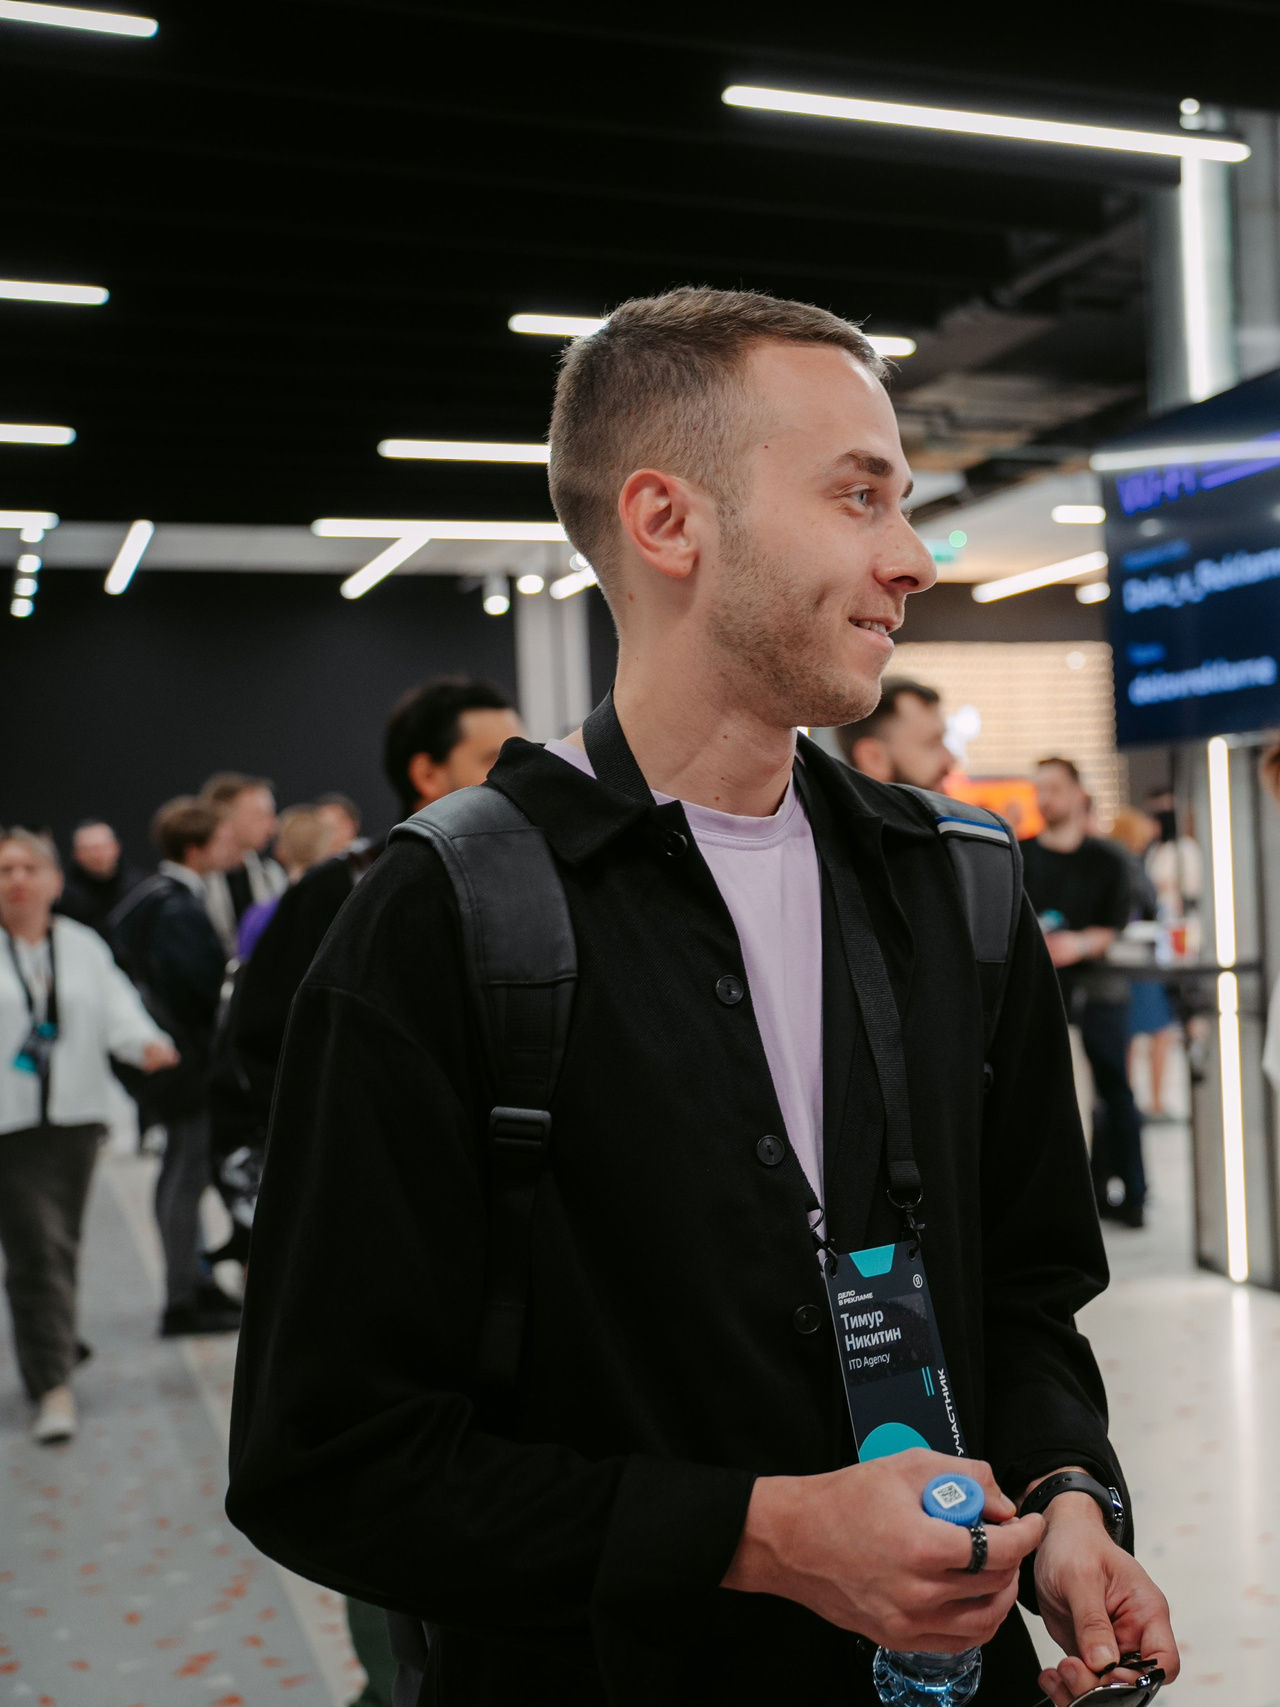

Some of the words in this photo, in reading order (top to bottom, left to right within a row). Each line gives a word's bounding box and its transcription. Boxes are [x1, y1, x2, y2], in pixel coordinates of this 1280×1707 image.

[838, 1290, 856, 1300] ДЕЛО
[844, 1292, 874, 1304] РЕКЛАМЕ
[840, 1310, 884, 1331] Тимур
[844, 1327, 902, 1351] Никитин
[849, 1358, 863, 1371] ITD
[863, 1353, 891, 1368] Agency
[937, 1368, 964, 1456] УЧАСТНИК
